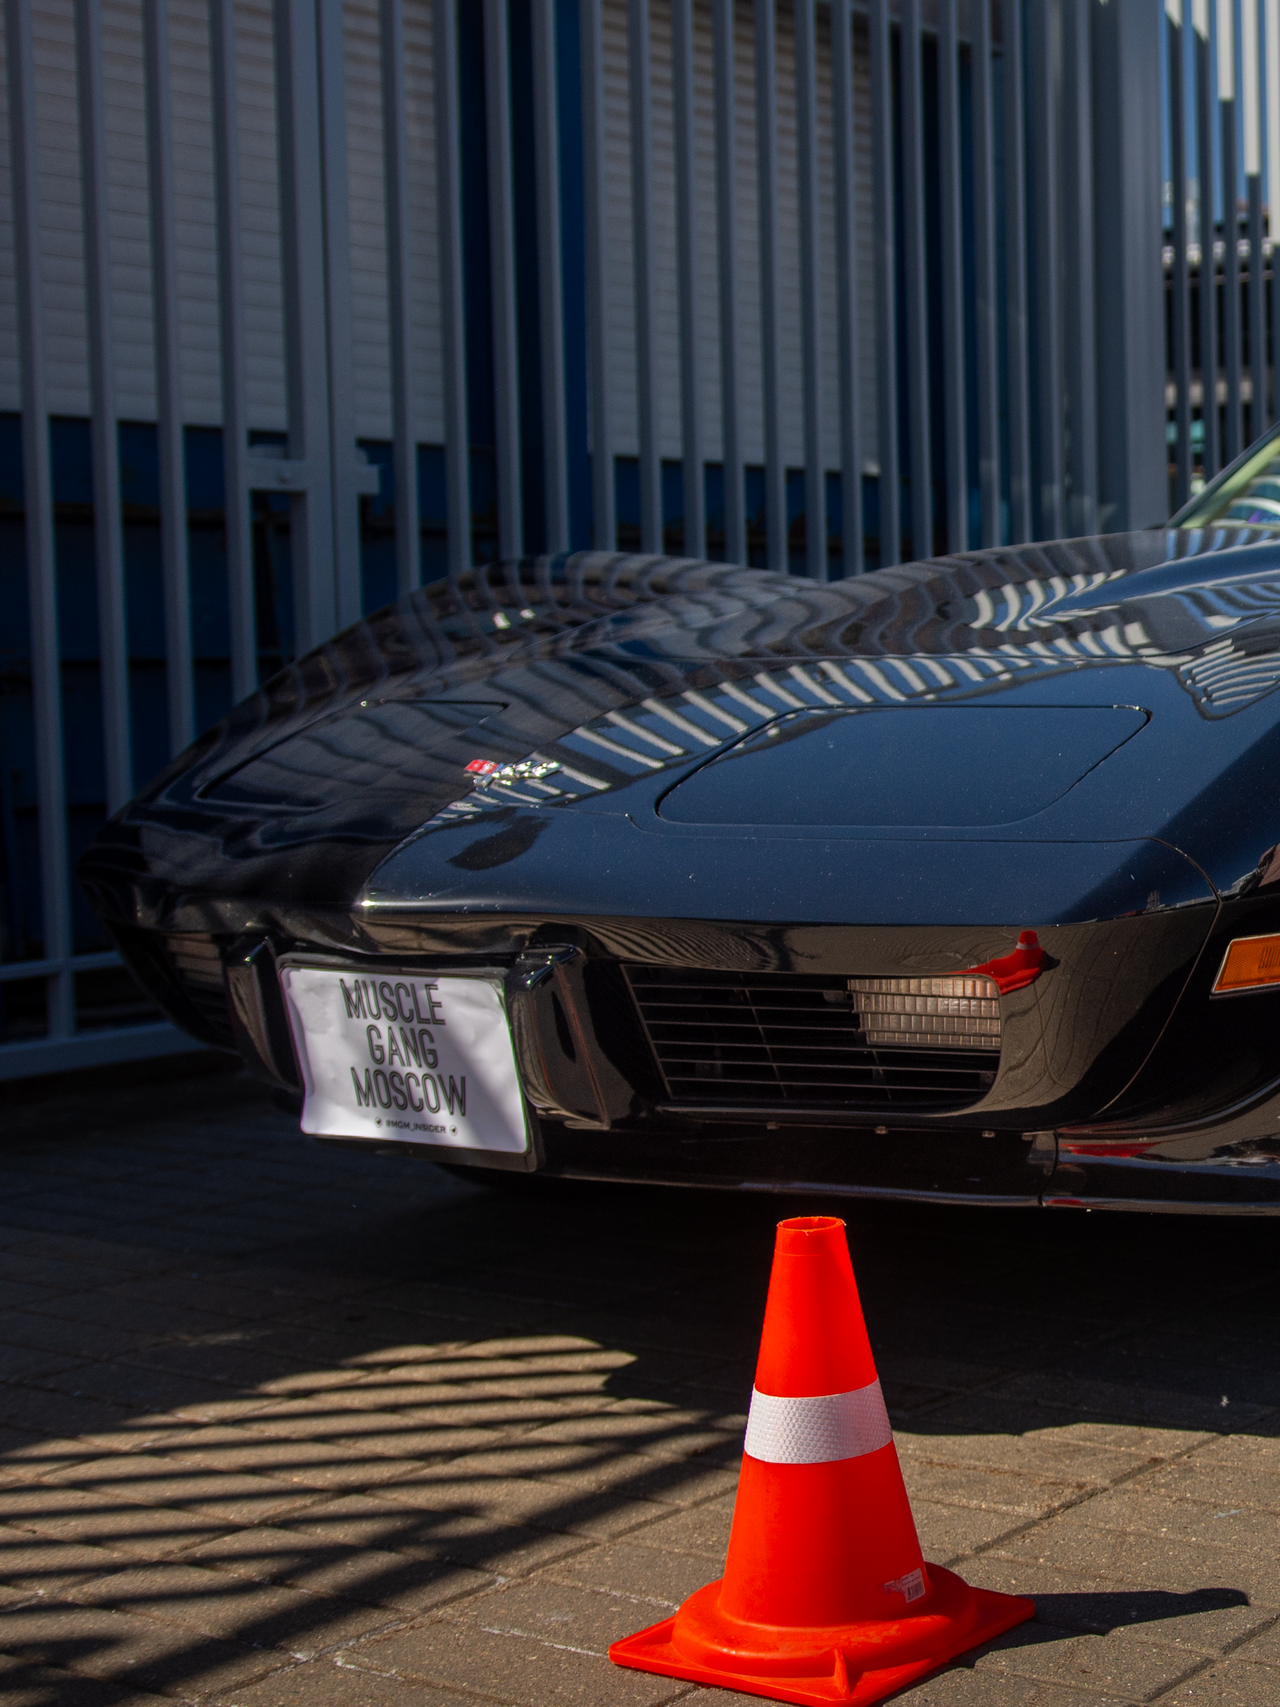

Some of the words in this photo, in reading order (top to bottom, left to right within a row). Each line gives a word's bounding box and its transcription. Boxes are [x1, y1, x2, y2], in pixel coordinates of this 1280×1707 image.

[339, 978, 446, 1026] MUSCLE
[366, 1024, 439, 1069] GANG
[350, 1066, 466, 1117] MOSCOW
